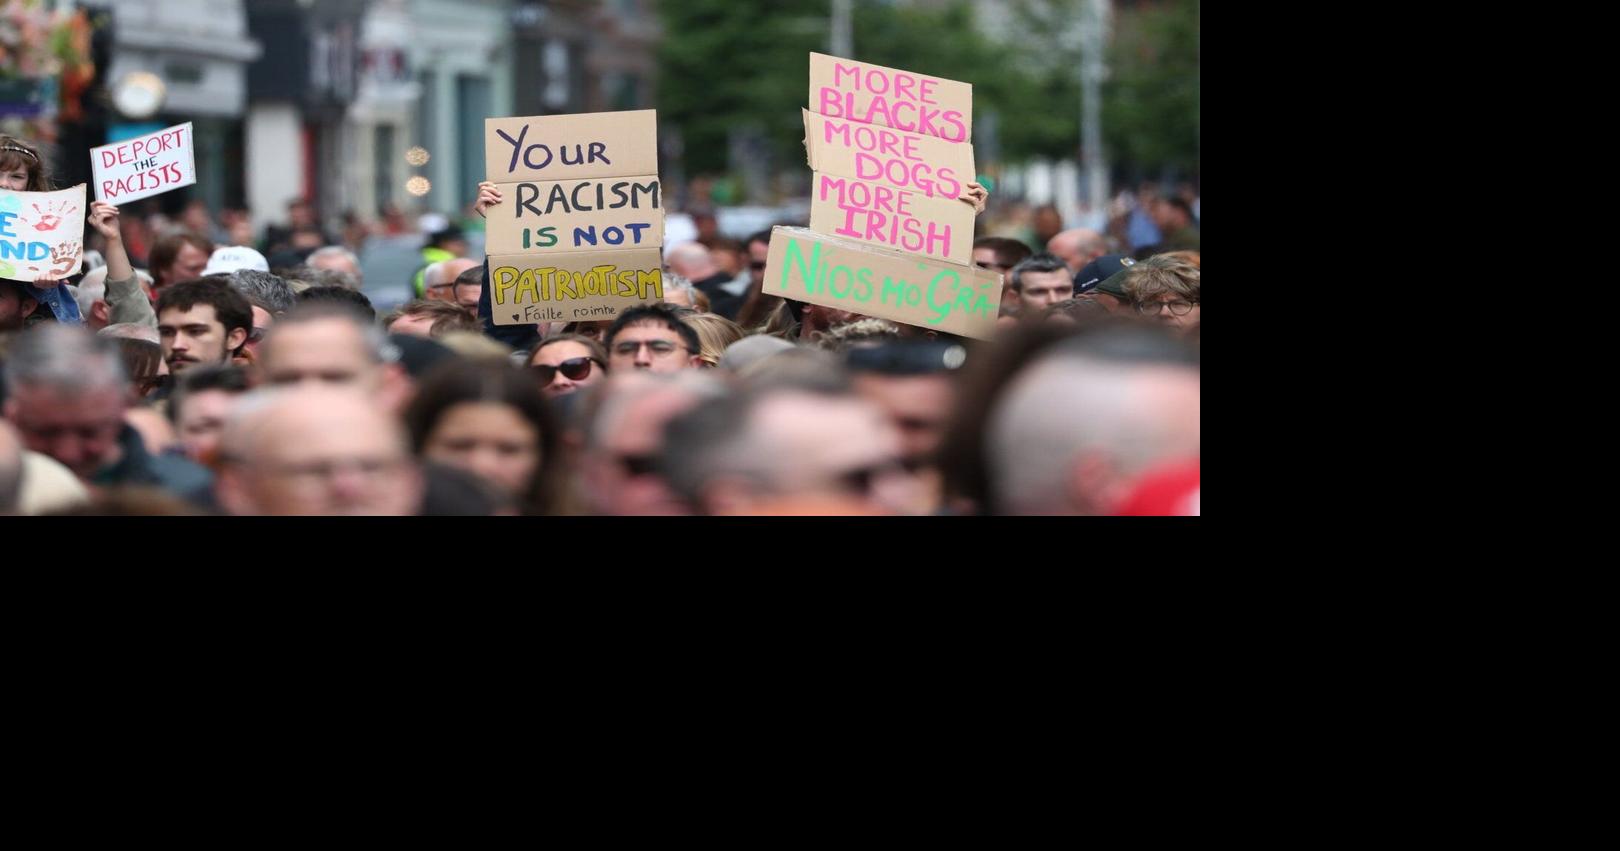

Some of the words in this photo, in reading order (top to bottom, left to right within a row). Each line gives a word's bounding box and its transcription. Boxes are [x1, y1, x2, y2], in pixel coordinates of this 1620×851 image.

[834, 63, 938, 105] MORE
[820, 87, 966, 143] BLACKS
[101, 128, 184, 168] DEPORT
[824, 121, 924, 161] MORE
[103, 162, 182, 199] RACISTS
[132, 156, 159, 171] THE
[856, 153, 961, 200] DOGS
[515, 181, 659, 218] RACISM
[819, 176, 913, 216] MORE
[522, 226, 558, 249] IS
[573, 223, 651, 247] NOT
[835, 202, 951, 257] IRISH
[493, 265, 663, 304] PATRIOTISM
[524, 305, 563, 322] Fáilte
